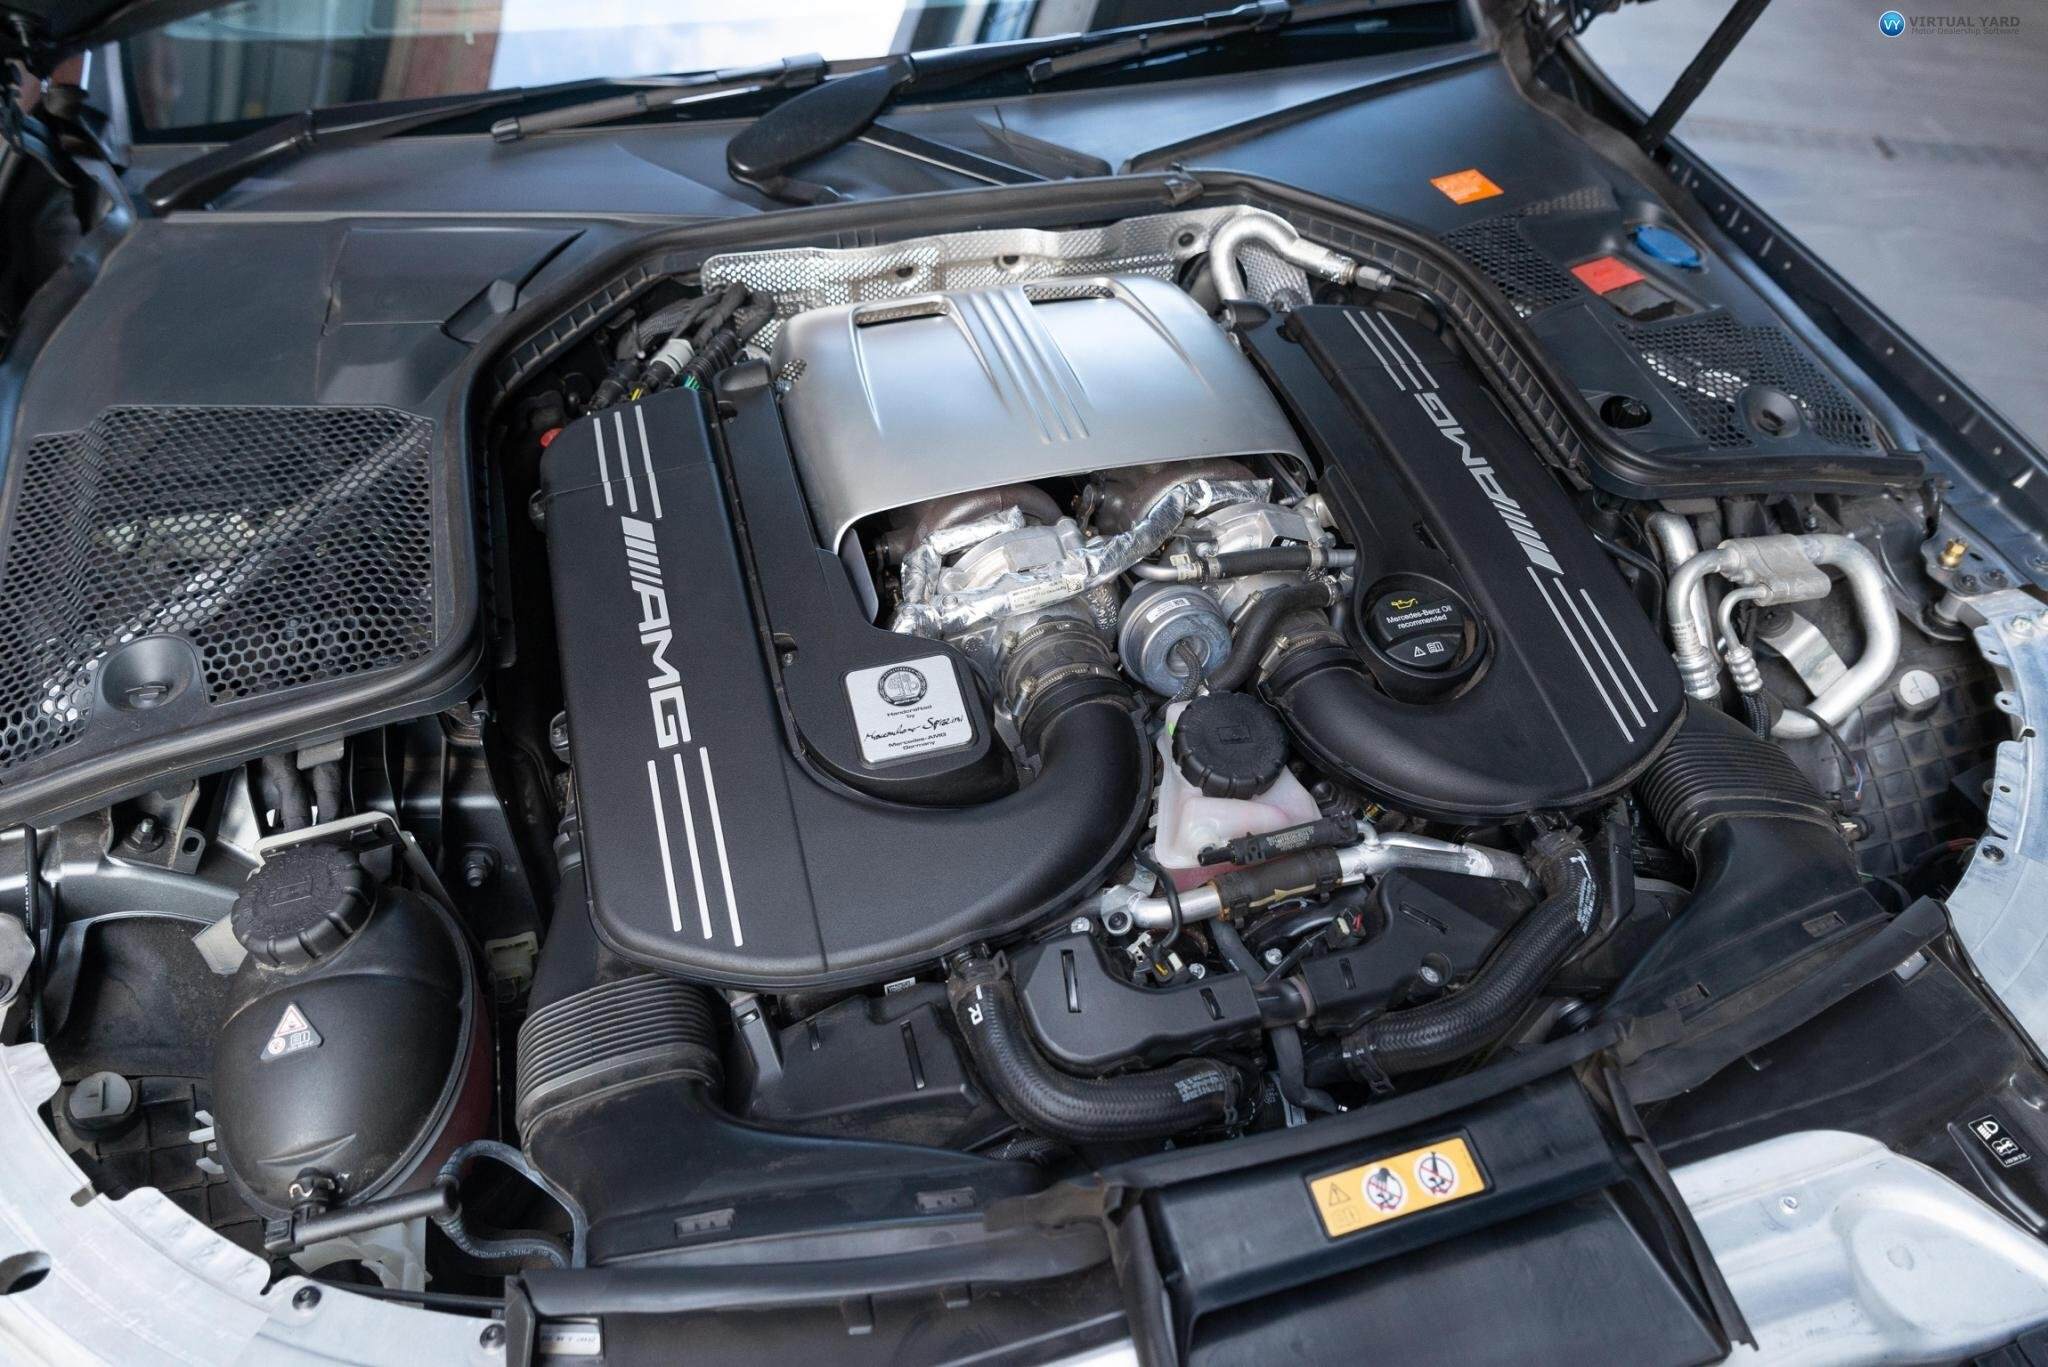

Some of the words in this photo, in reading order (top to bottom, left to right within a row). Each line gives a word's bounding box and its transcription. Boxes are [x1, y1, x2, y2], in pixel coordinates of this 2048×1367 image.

[1386, 607, 1441, 624] Mercedes-Benz
[1441, 604, 1453, 613] Oil
[1397, 614, 1447, 629] recommended
[632, 579, 692, 749] AMG
[887, 704, 932, 717] Handcrafted
[888, 732, 947, 748] Mercedes-AMG
[902, 741, 936, 751] Germany
